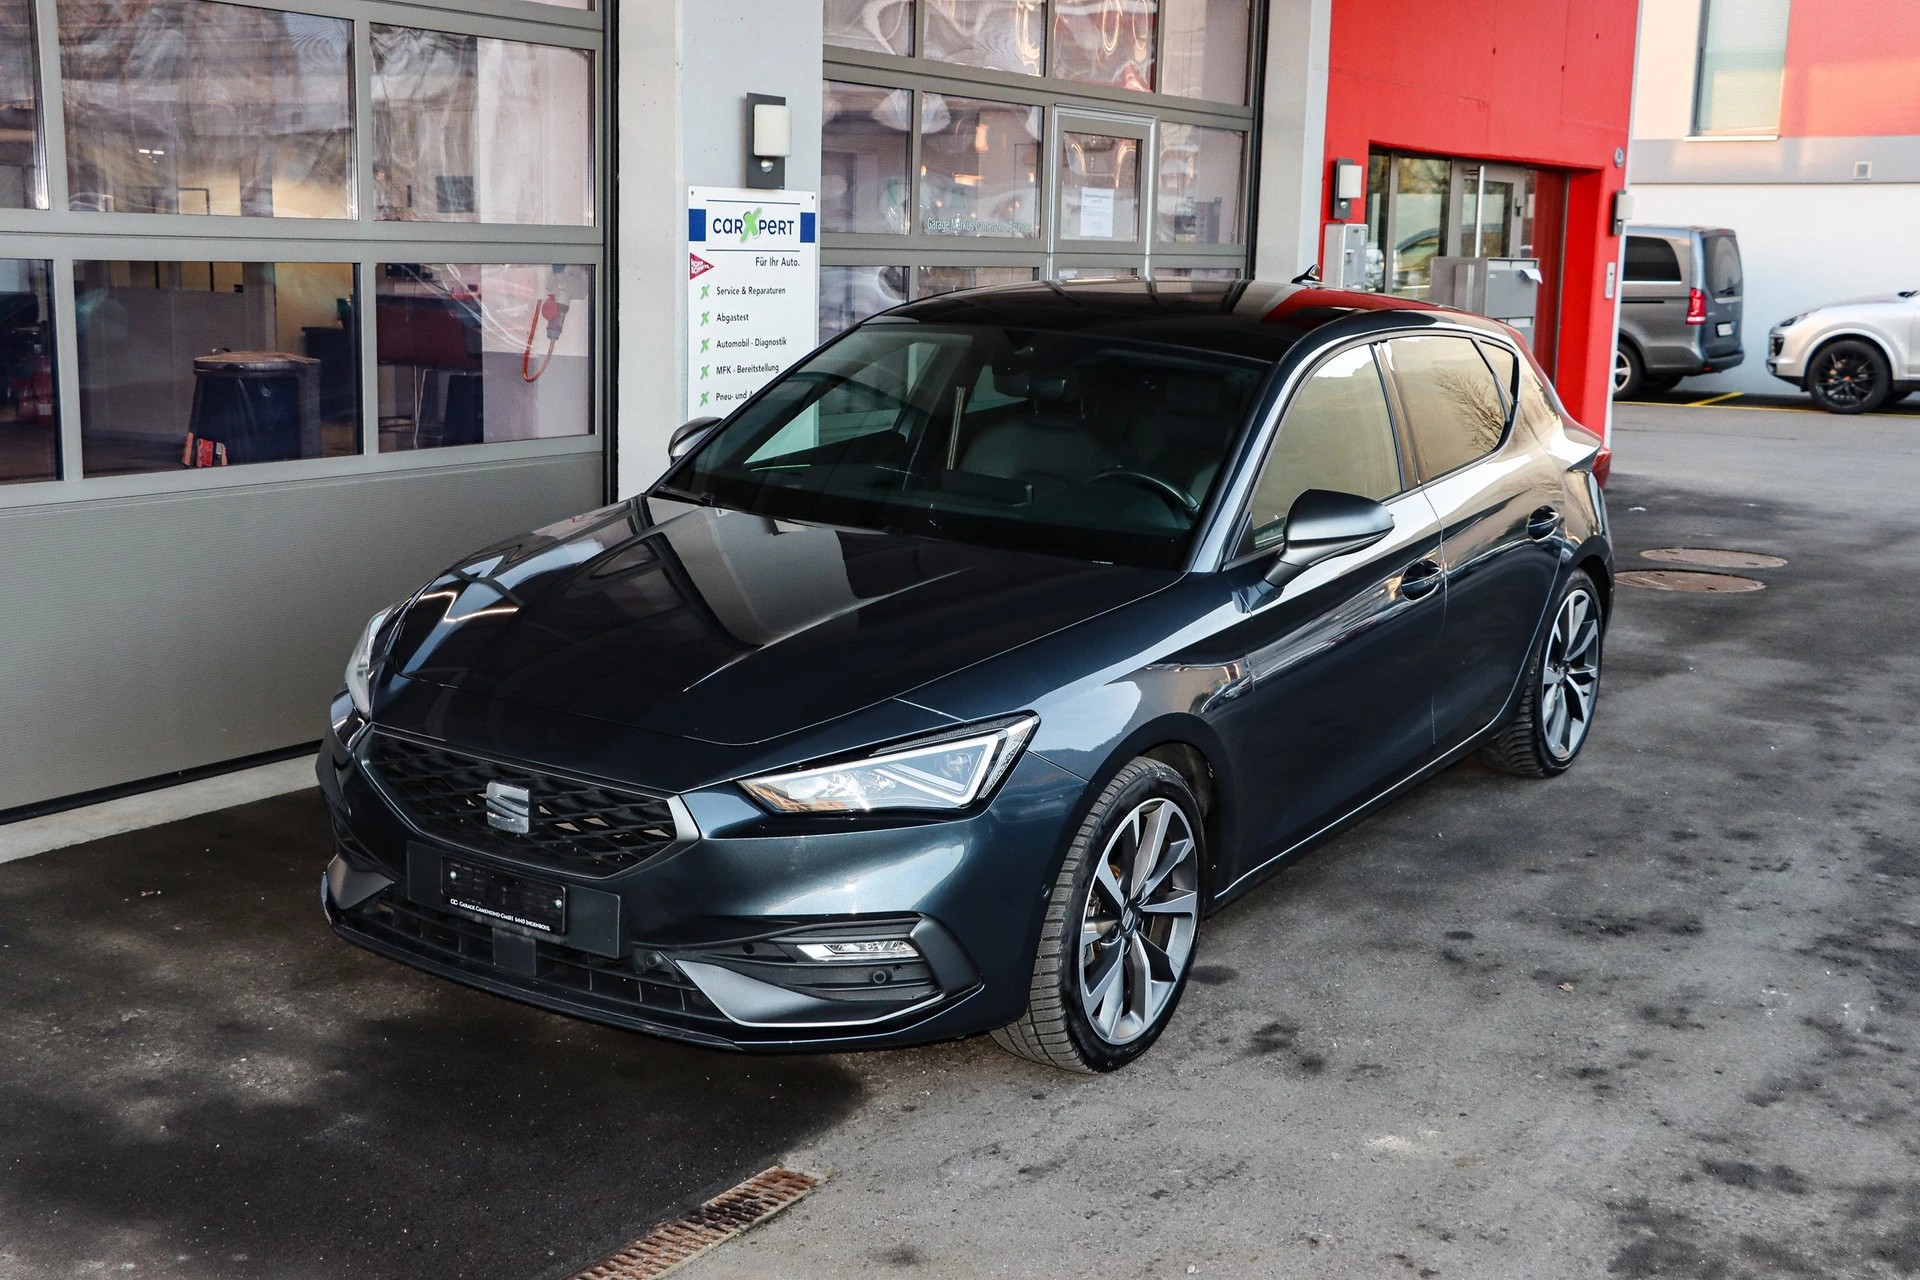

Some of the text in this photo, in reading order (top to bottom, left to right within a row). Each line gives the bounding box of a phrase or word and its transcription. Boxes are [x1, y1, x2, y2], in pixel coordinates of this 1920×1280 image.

[927, 217, 949, 232] Garage
[755, 256, 800, 267] Für Ihr Auto.
[716, 286, 786, 297] Service & Reparaturen
[716, 313, 749, 324] Abgastest
[716, 338, 750, 349] Automobil
[754, 337, 787, 349] Diagnostik
[716, 366, 732, 375] MFK
[737, 363, 780, 374] Bereitstellung
[716, 392, 734, 401] Pneu-
[735, 390, 747, 400] und
